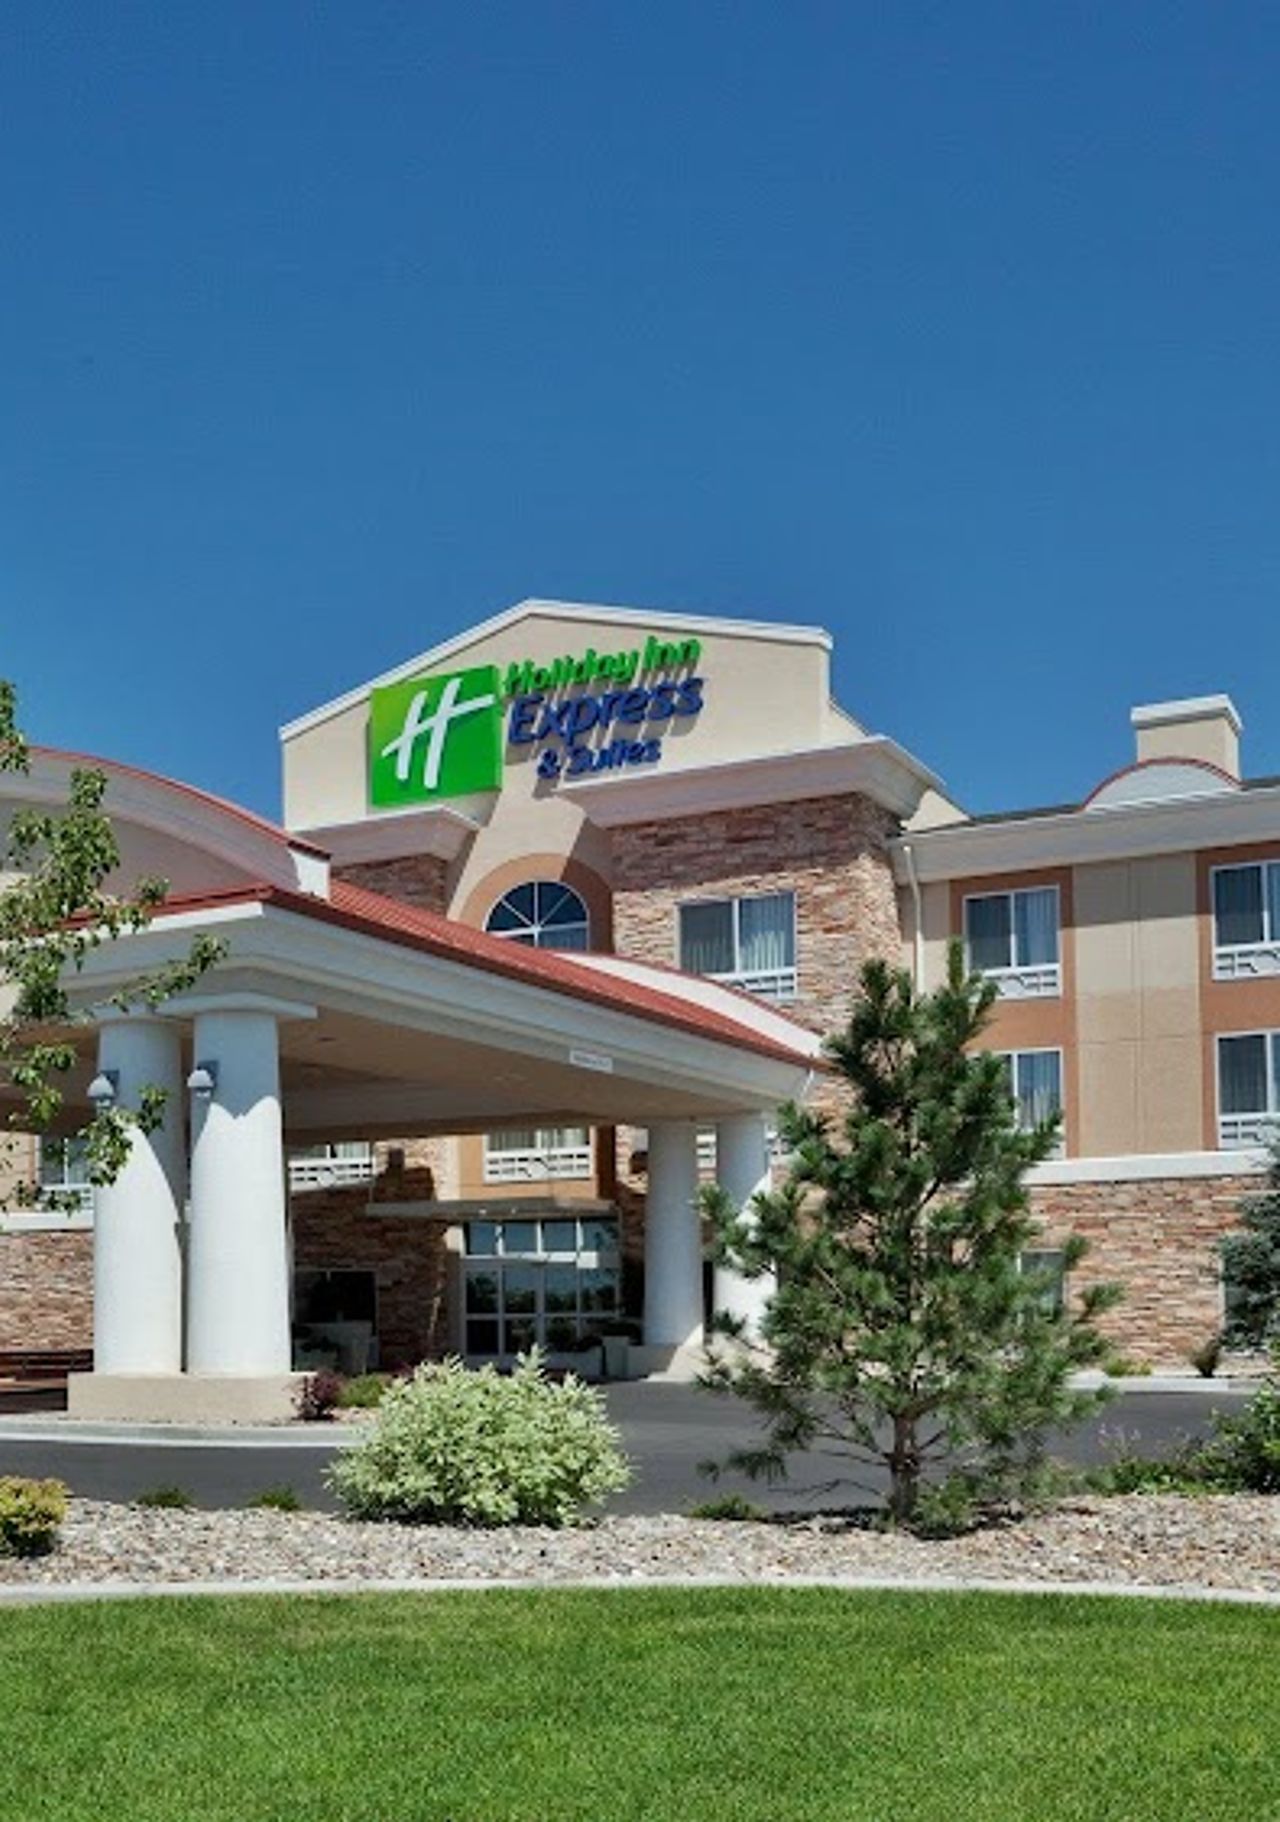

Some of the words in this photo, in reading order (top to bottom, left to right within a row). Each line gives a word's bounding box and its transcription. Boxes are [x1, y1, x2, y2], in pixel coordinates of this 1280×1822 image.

[503, 649, 639, 694] Holiday
[642, 636, 702, 671] Inn
[381, 677, 495, 789] H
[508, 677, 706, 746] Express
[537, 749, 561, 779] &
[567, 738, 661, 775] Suites
